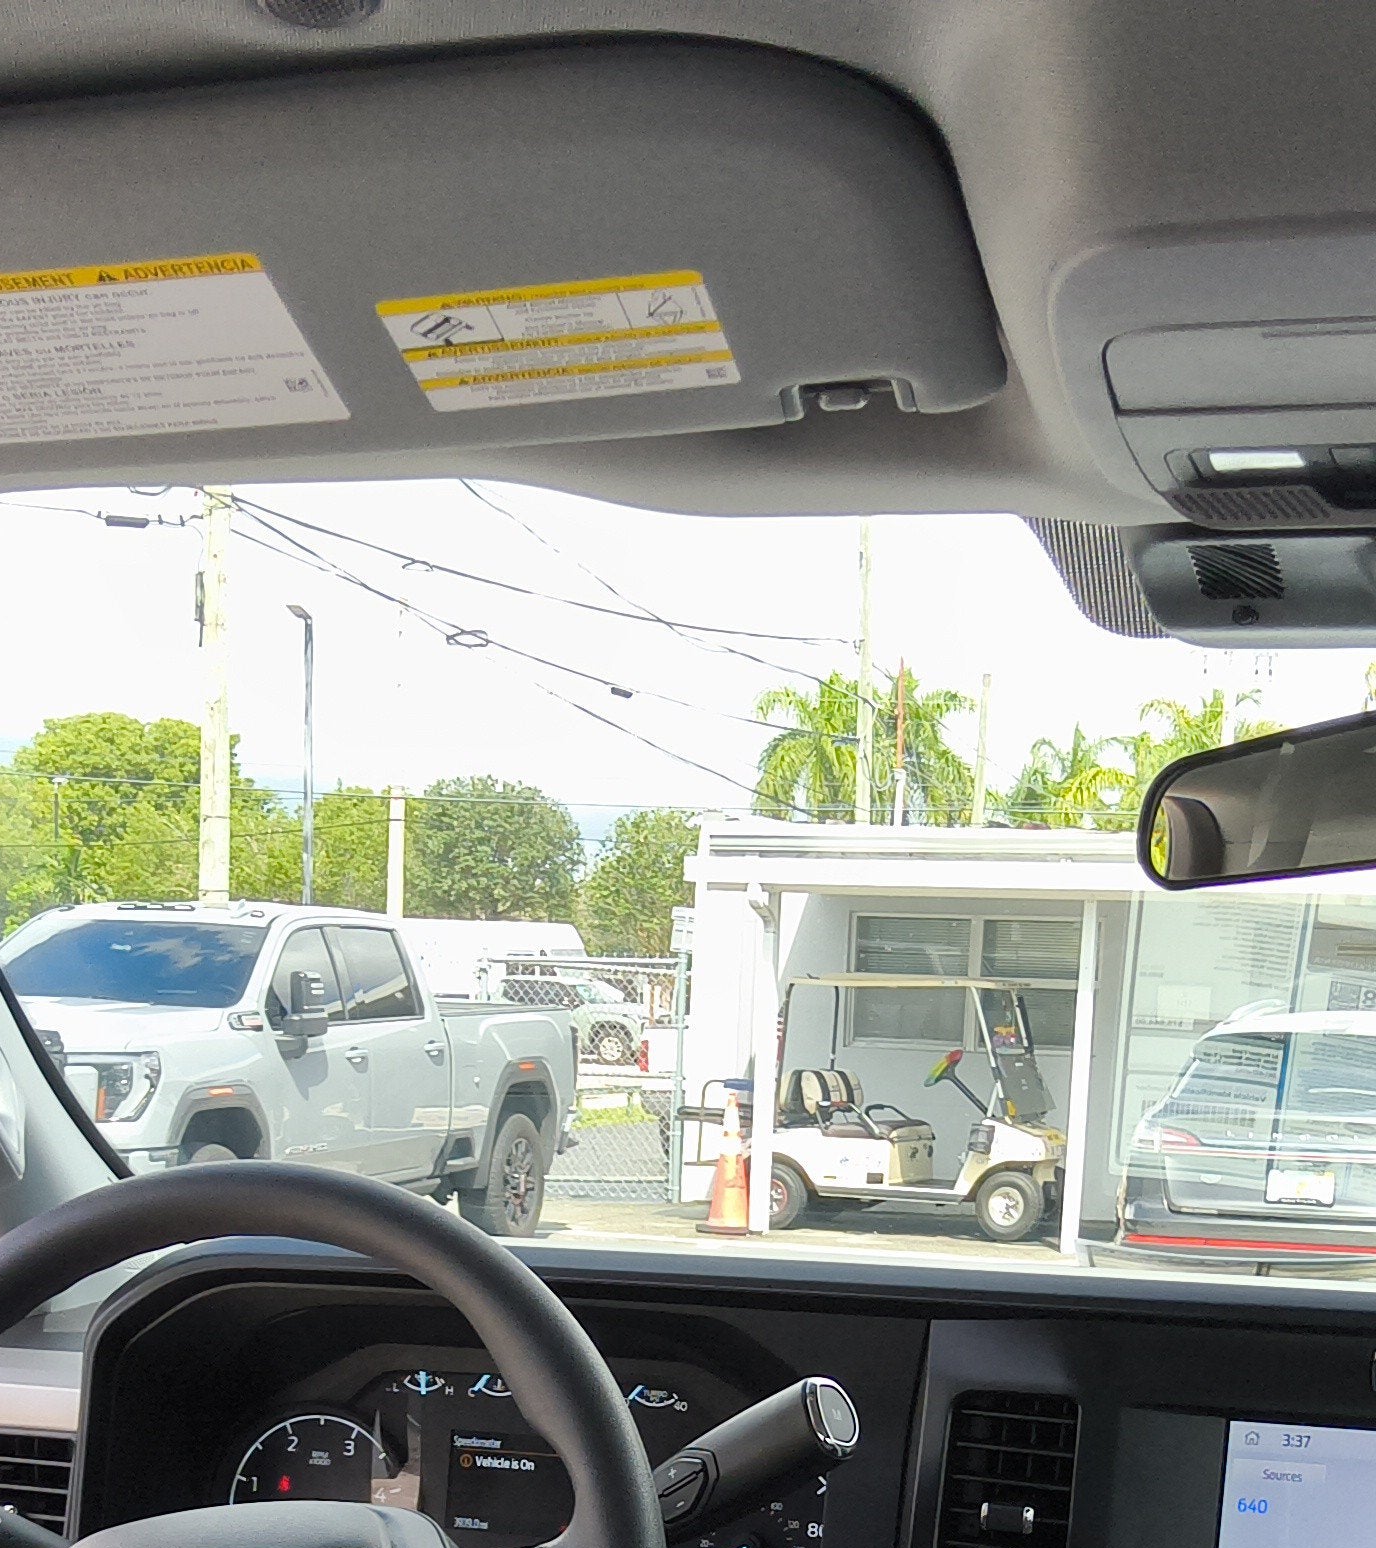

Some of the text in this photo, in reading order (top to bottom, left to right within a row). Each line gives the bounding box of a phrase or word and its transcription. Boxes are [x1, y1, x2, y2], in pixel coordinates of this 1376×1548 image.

[123, 256, 254, 281] ADVERTENCIA
[673, 1401, 689, 1412] 40
[287, 1435, 299, 1452] 2
[342, 1440, 355, 1456] 3
[1281, 1432, 1312, 1450] 3:37
[475, 1455, 535, 1471] Vehicle is On
[250, 1476, 259, 1492] 1
[1262, 1468, 1304, 1484] Sources
[373, 1486, 387, 1503] 4
[1237, 1497, 1269, 1516] 640
